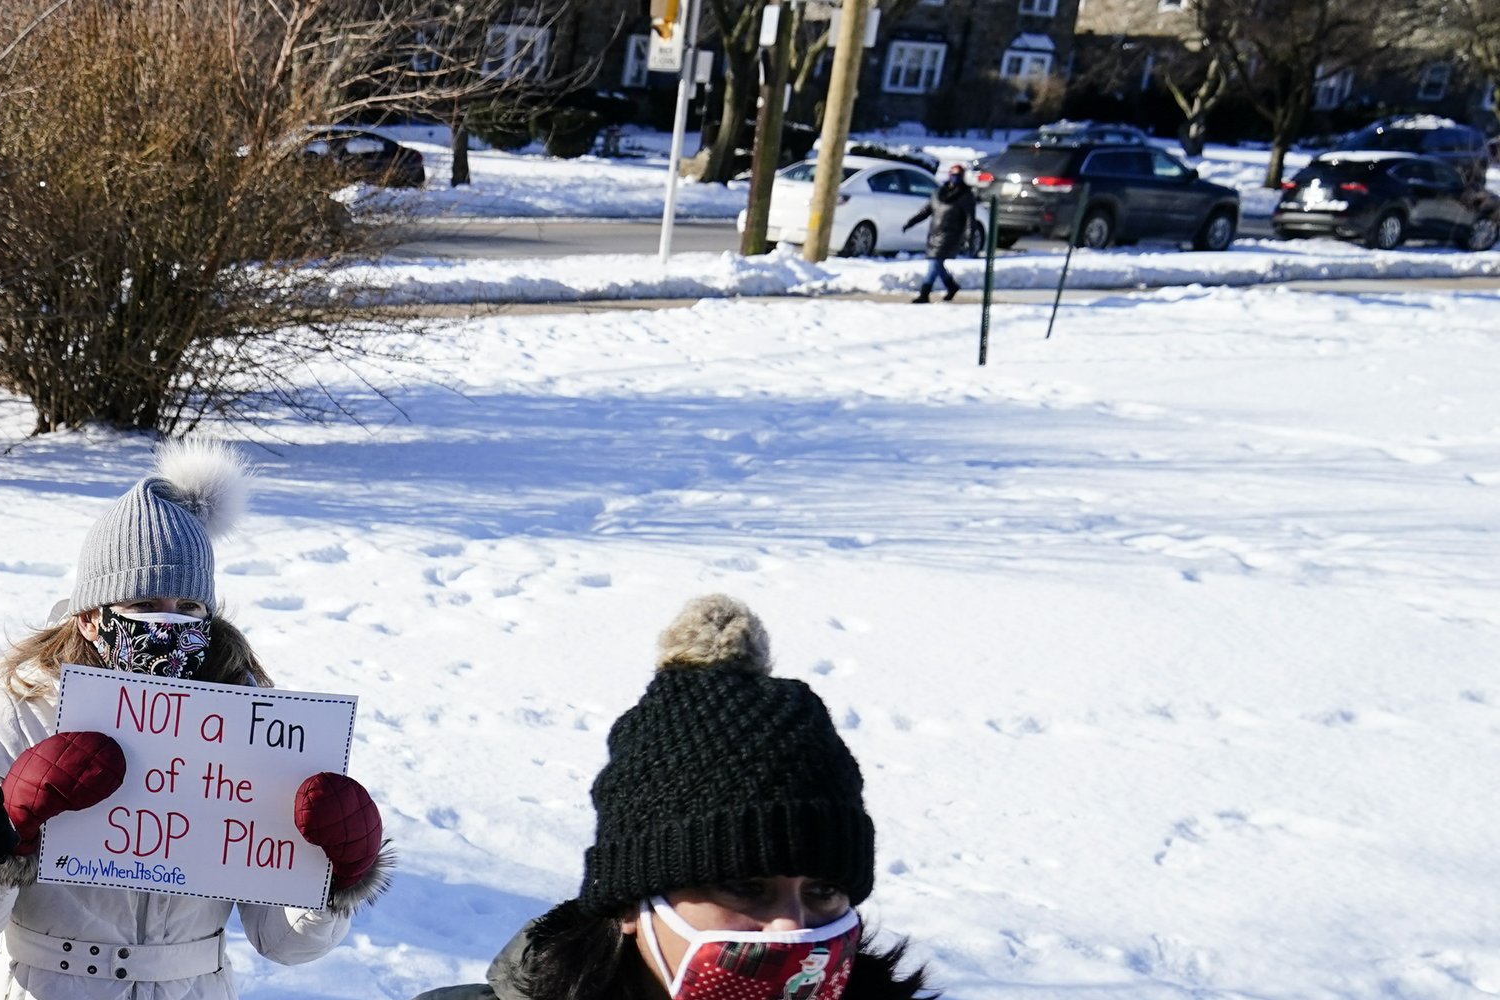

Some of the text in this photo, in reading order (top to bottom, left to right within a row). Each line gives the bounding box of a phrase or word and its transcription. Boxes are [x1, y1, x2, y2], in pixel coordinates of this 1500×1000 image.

[115, 685, 305, 753] NOT a Fan
[145, 757, 254, 803] of the
[104, 806, 296, 870] SDP Plan
[55, 855, 187, 886] #OnlyWhenItsSafe
